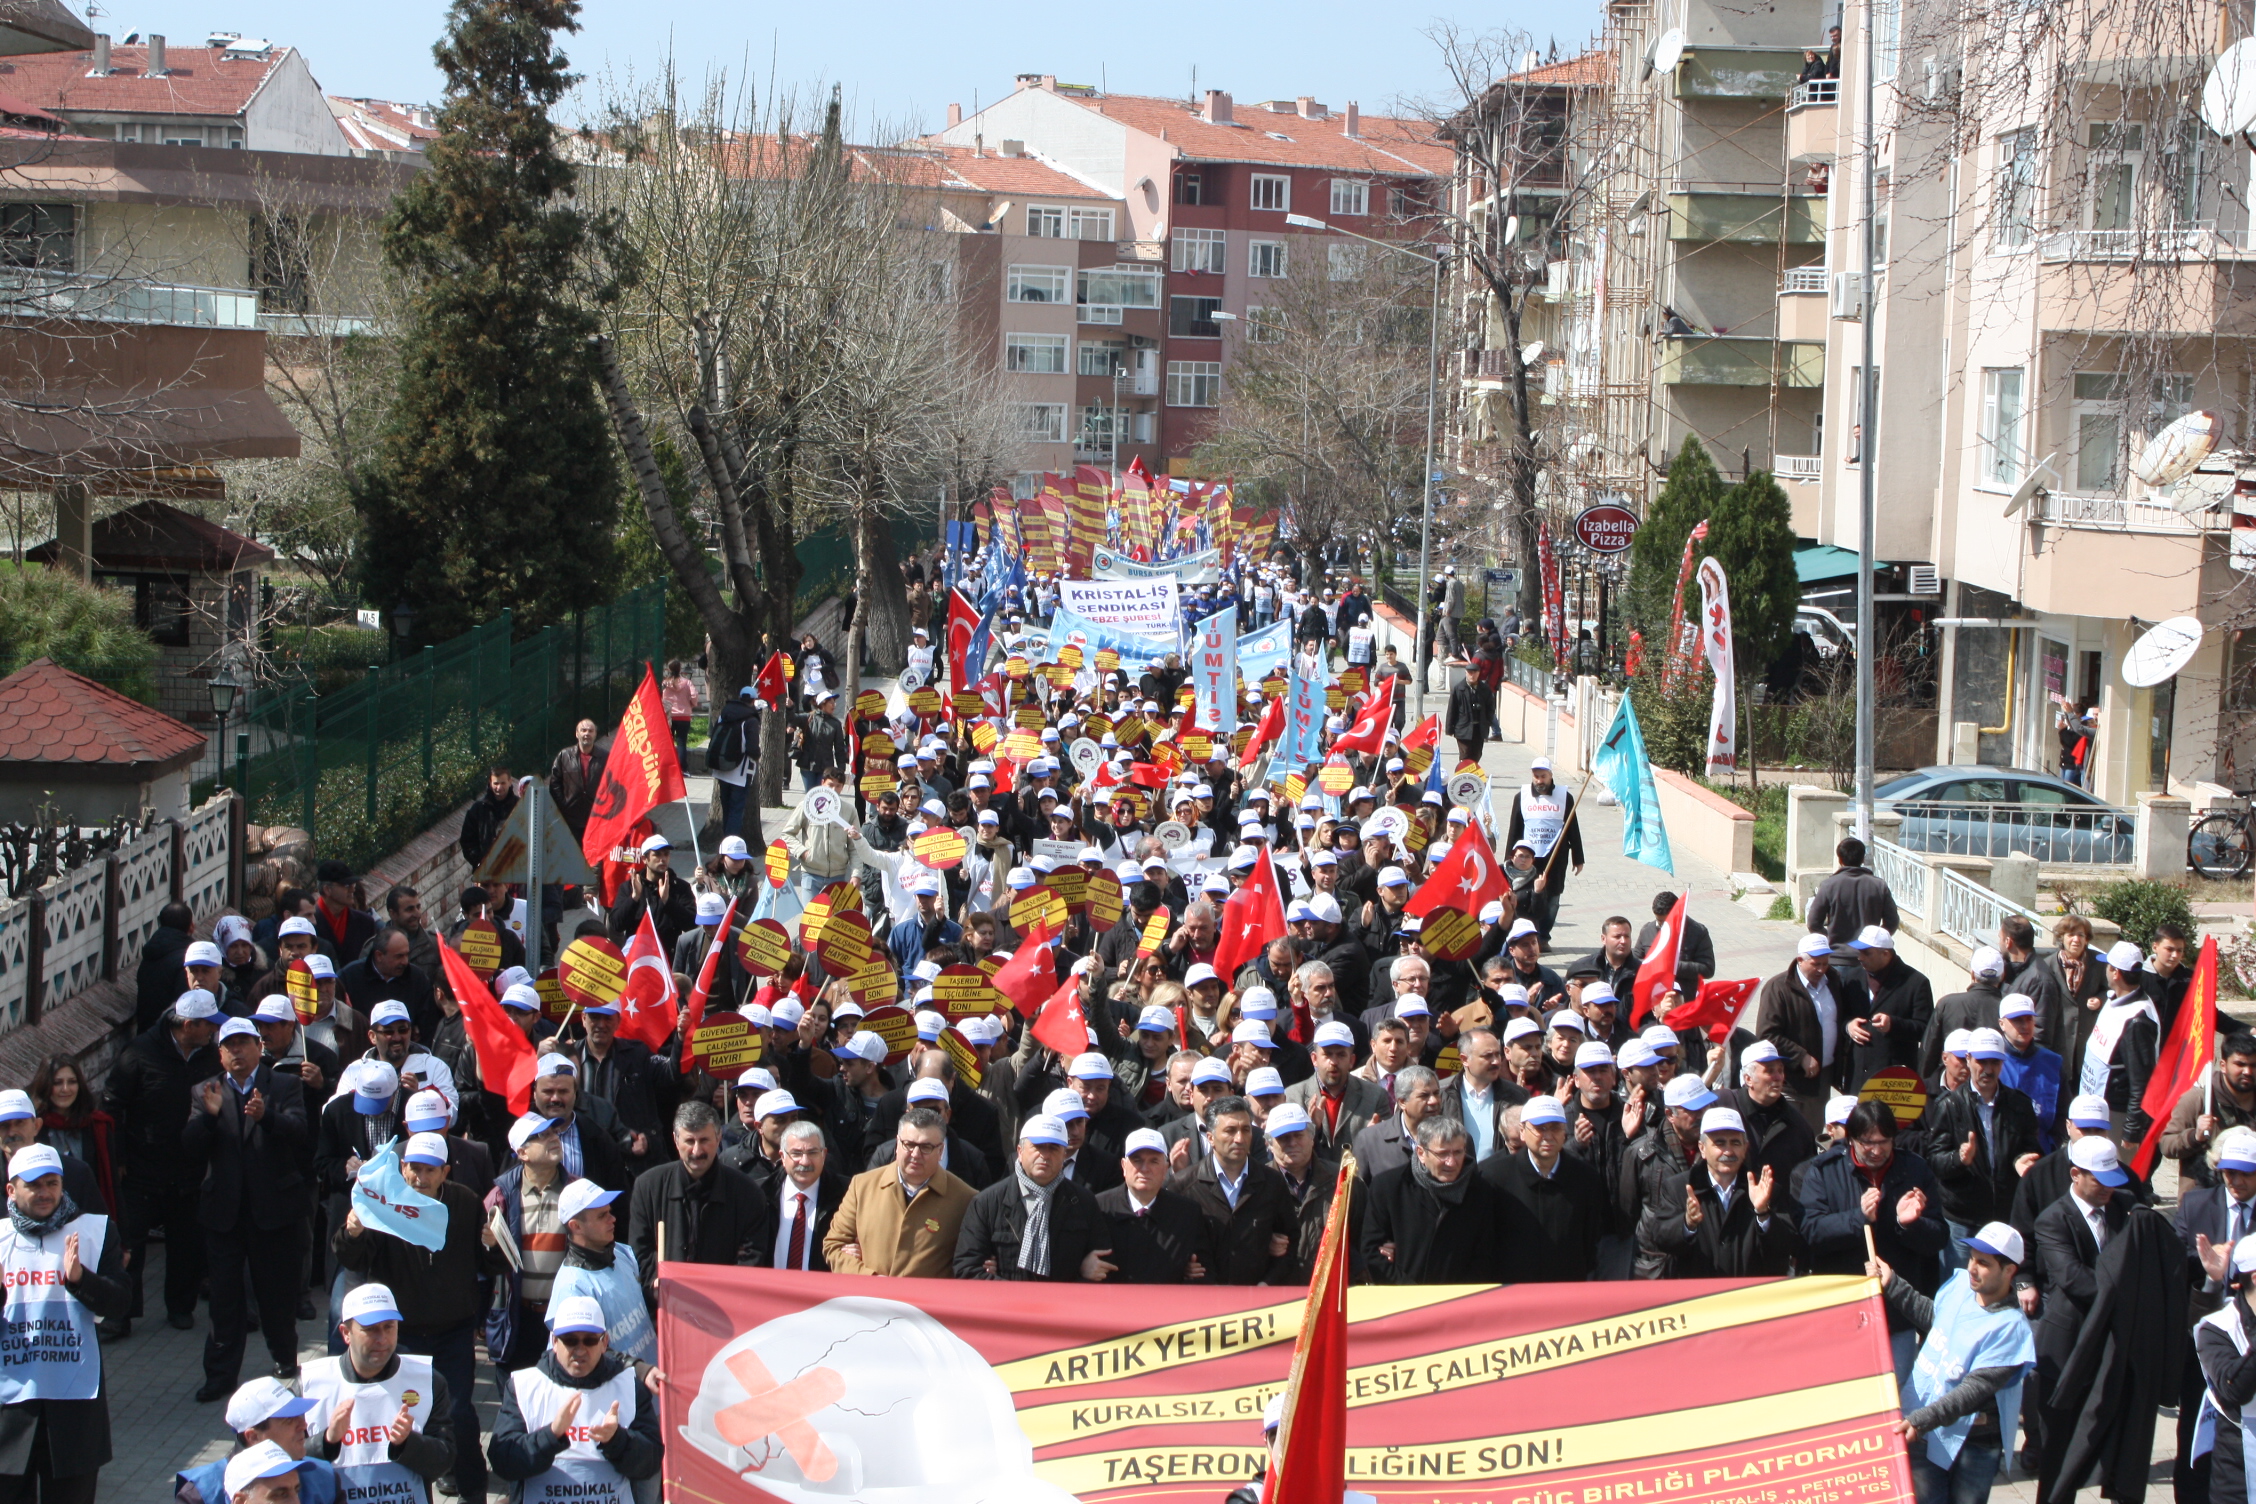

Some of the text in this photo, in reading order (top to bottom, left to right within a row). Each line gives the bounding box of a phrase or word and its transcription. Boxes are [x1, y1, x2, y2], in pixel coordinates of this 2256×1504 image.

[1590, 532, 1626, 546] Pizza
[1128, 568, 1153, 578] BURSA
[1071, 584, 1169, 601] KRİSTAL-İŞ
[1076, 600, 1166, 613] SENDİKASI
[362, 612, 376, 624] M-5
[1123, 614, 1162, 624] ŞUBESİ
[1527, 803, 1560, 812] GÖREVLİ
[928, 834, 952, 843] TAŞERON
[1058, 874, 1083, 883] TAŞERON
[1099, 881, 1118, 892] TAŞERON
[1023, 893, 1049, 909] TAŞERON
[473, 932, 495, 942] KURALSIZ
[758, 928, 785, 943] TAŞERON
[832, 920, 869, 940] GÜVENCESİZ
[469, 944, 495, 954] ÇALIŞMAYA
[749, 936, 781, 956] İŞÇİLİĞİNE
[830, 934, 862, 954] ÇALIŞMAYA
[1450, 936, 1466, 951] SON!
[470, 957, 490, 967] HAYIR!
[585, 949, 621, 970] KURALSIZ
[748, 950, 767, 963] SON!
[826, 947, 851, 964] HAYIR!
[573, 959, 613, 984] ÇALIŞMAYA
[861, 964, 885, 975] TAŞERON
[569, 973, 600, 993] HAYIR!
[860, 975, 889, 988] İŞÇİLİĞİNE
[949, 977, 980, 986] TAŞERON
[867, 989, 884, 998] SON!
[944, 988, 982, 999] İŞÇİLİĞİNE
[950, 1002, 971, 1011] SON!
[863, 1016, 906, 1030] GÜVENCESİZ
[700, 1024, 747, 1038] GÜVENCESİZ
[706, 1038, 748, 1052] ÇALIŞMAYA
[950, 1038, 976, 1064] KURALSIZ
[711, 1053, 742, 1066] HAYIR!
[1880, 1080, 1914, 1089] TAŞERON
[5, 1267, 67, 1288] GÖREV
[8, 1317, 75, 1335] SENDİKAL
[1, 1333, 82, 1351] GÜÇ BİRLİĞİ
[1043, 1313, 1276, 1385] ARTIK YETER!
[3, 1350, 81, 1366] PLATFORMU
[1071, 1400, 1226, 1430] KURALSIZ,
[1425, 1333, 1584, 1391] ÇALIŞMAYA
[1591, 1313, 1688, 1348] HAYIR!
[1103, 1452, 1267, 1484] TAŞERON
[1476, 1437, 1564, 1473] SON!
[1582, 1471, 1694, 1502] BİRLİĞİ
[1702, 1434, 1884, 1485] PLATFORMU
[1801, 1466, 1889, 1494] PETROL-İŞ
[545, 1481, 616, 1499] SENDİKAL
[1857, 1480, 1892, 1495] TGS
